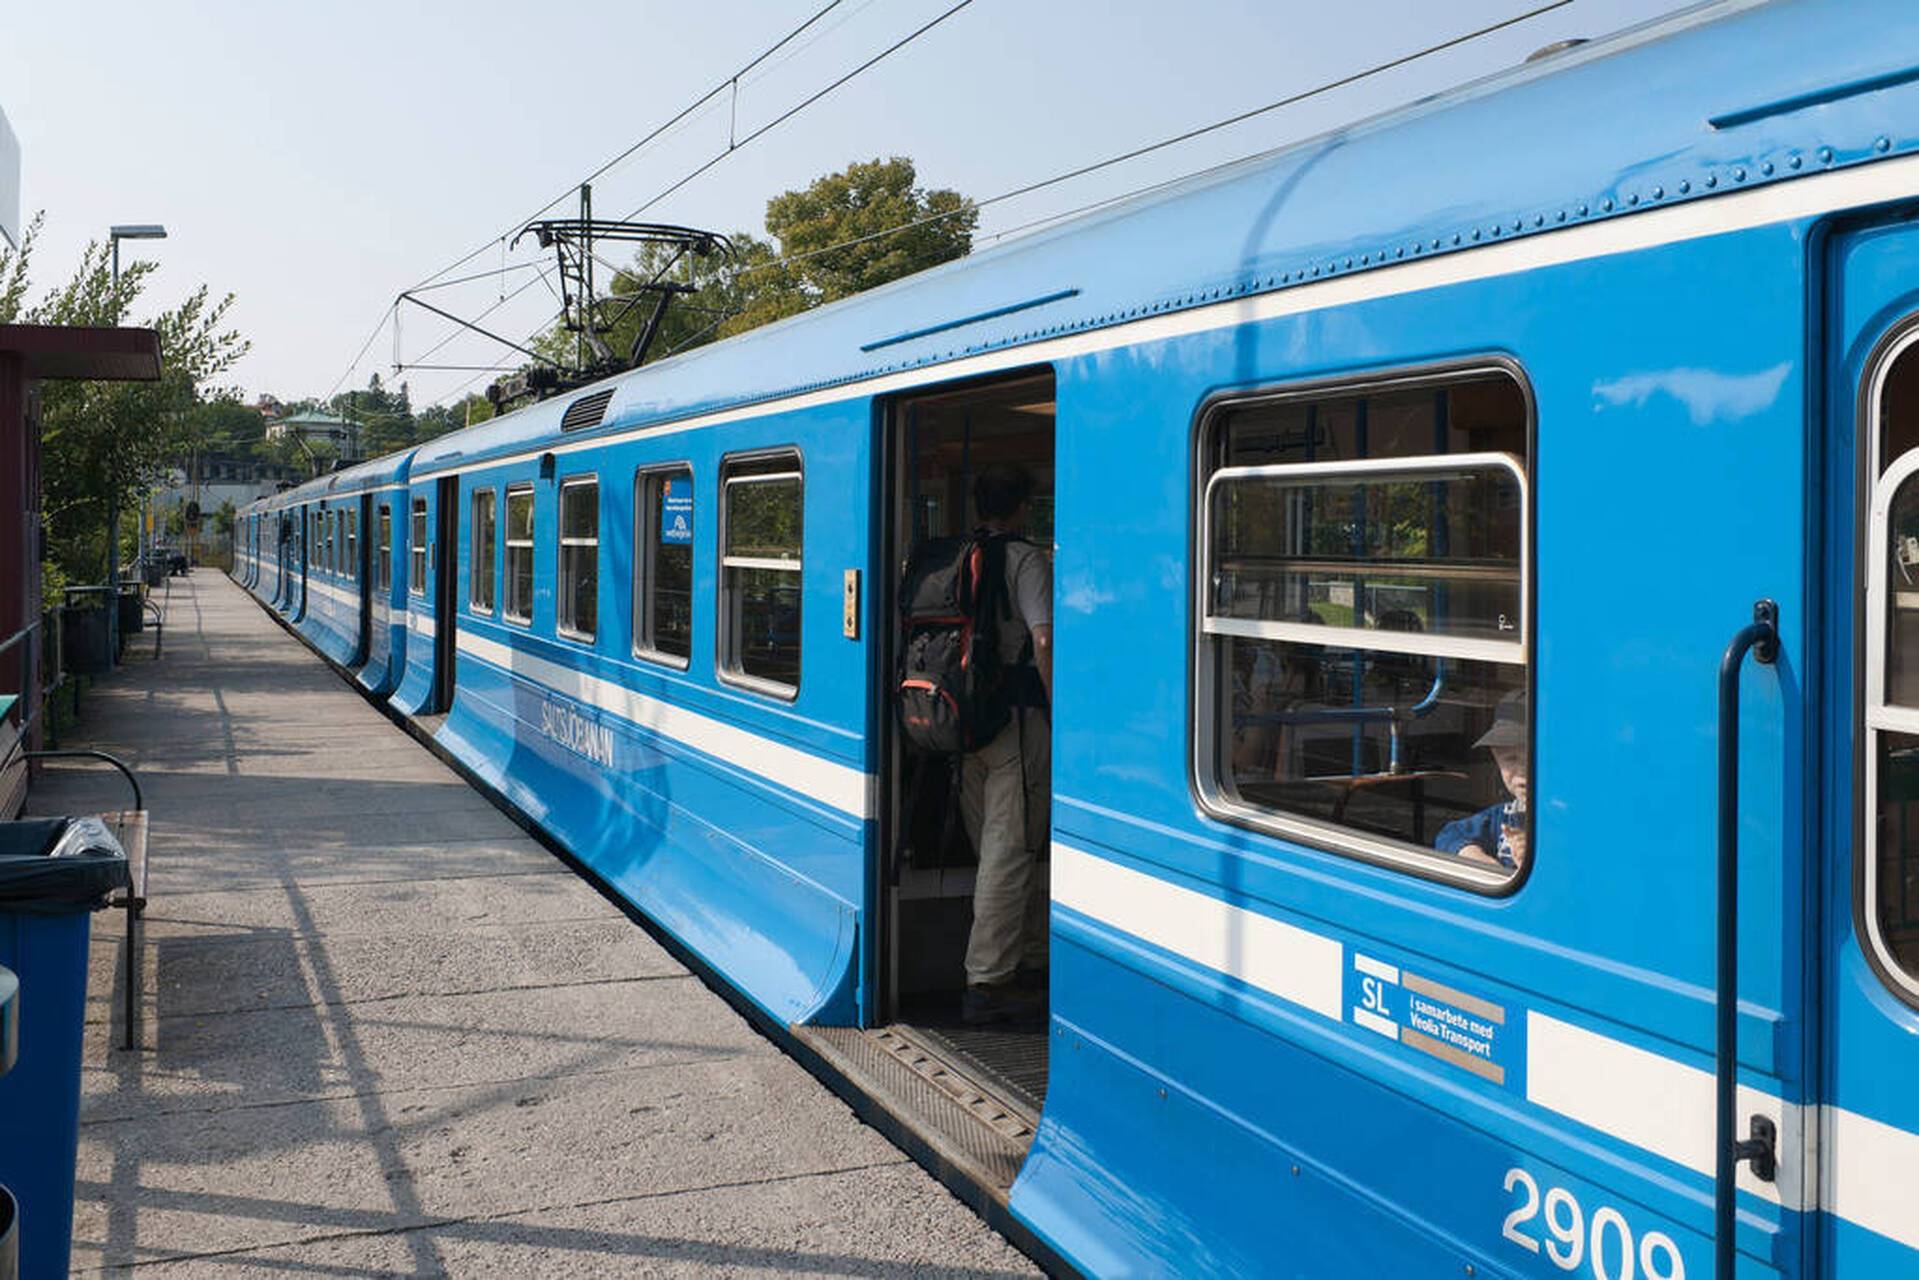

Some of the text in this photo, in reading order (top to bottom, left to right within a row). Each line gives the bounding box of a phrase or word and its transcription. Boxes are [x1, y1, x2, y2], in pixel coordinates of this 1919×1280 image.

[1362, 976, 1390, 1016] SL
[1410, 993, 1493, 1040] I samarbete med
[1410, 1011, 1490, 1058] Veolia Transport
